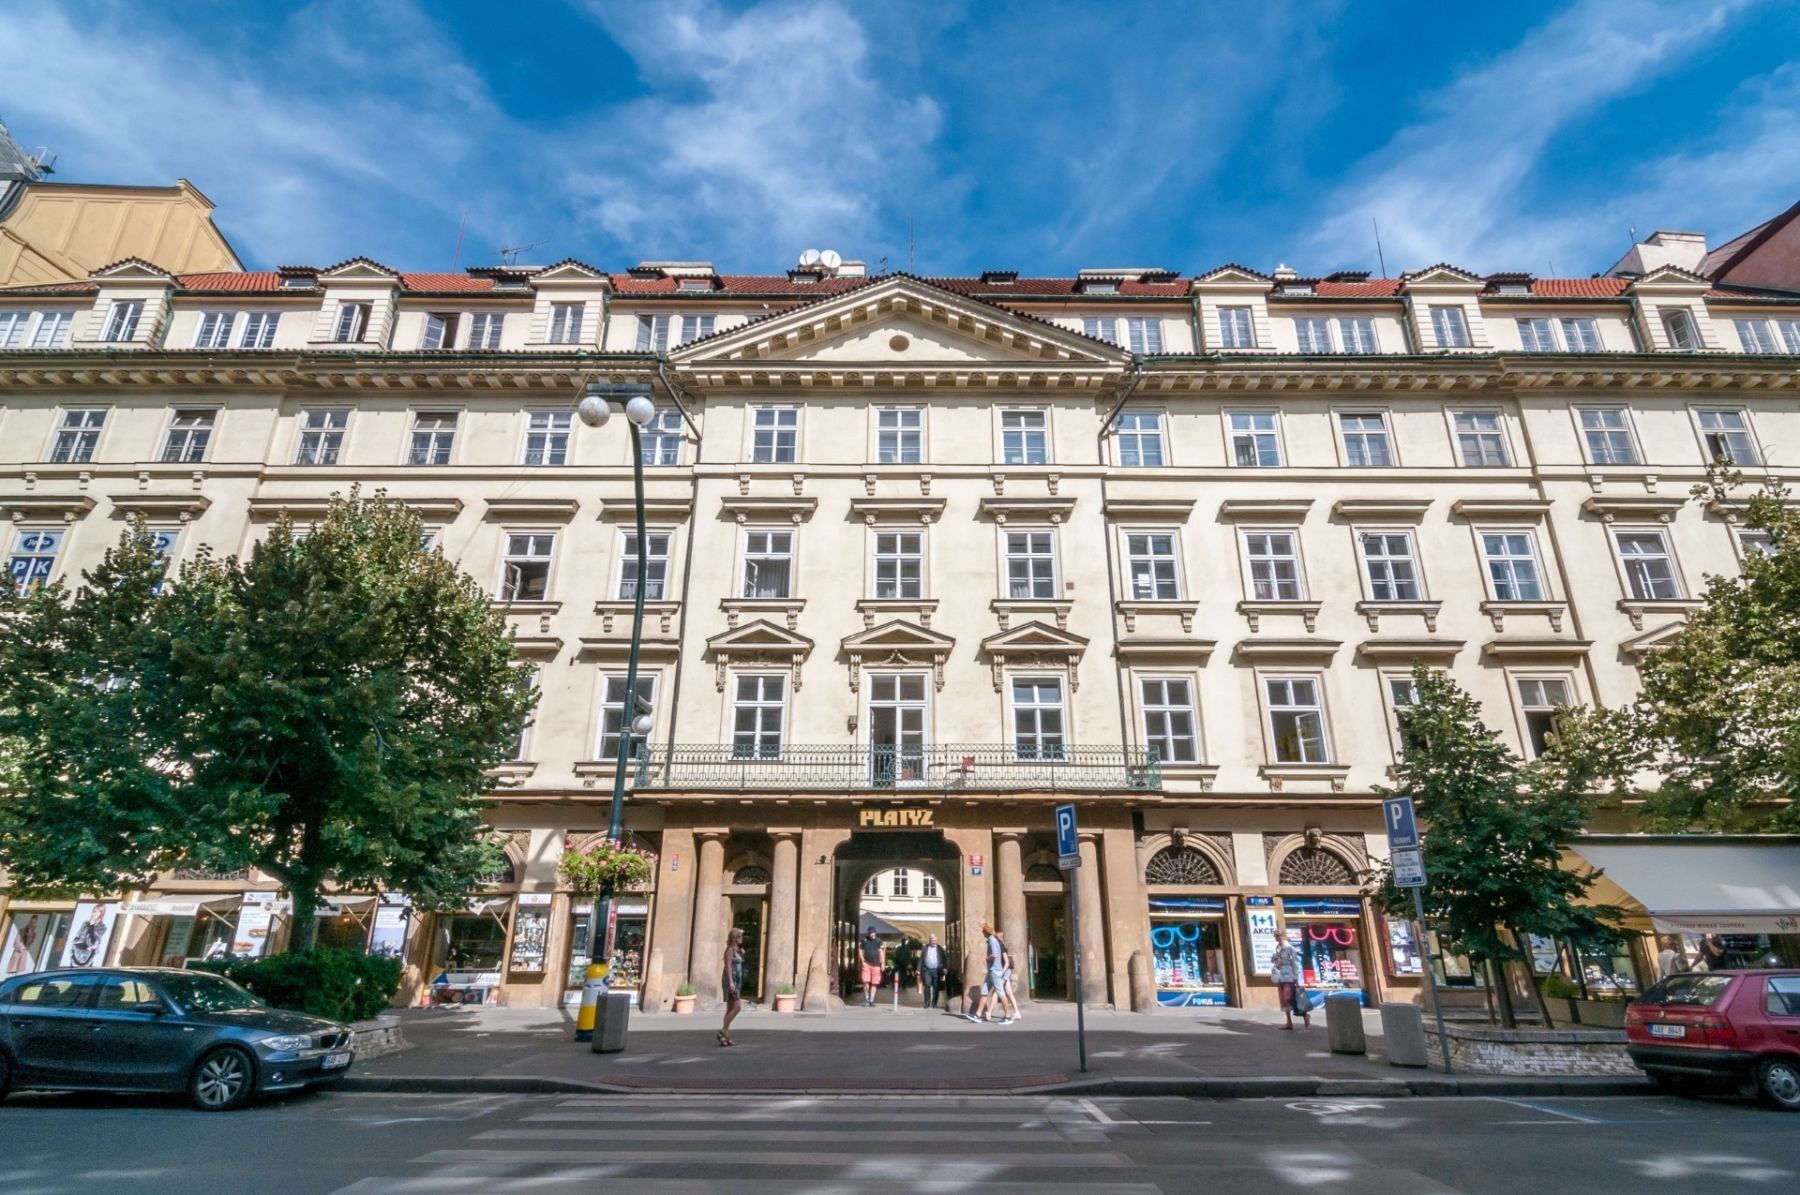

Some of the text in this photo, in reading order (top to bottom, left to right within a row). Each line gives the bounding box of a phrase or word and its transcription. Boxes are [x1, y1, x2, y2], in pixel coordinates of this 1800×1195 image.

[860, 809, 934, 826] PLATYZ
[1060, 812, 1071, 841] P
[1391, 803, 1403, 830] P
[1251, 914, 1274, 927] 1+1
